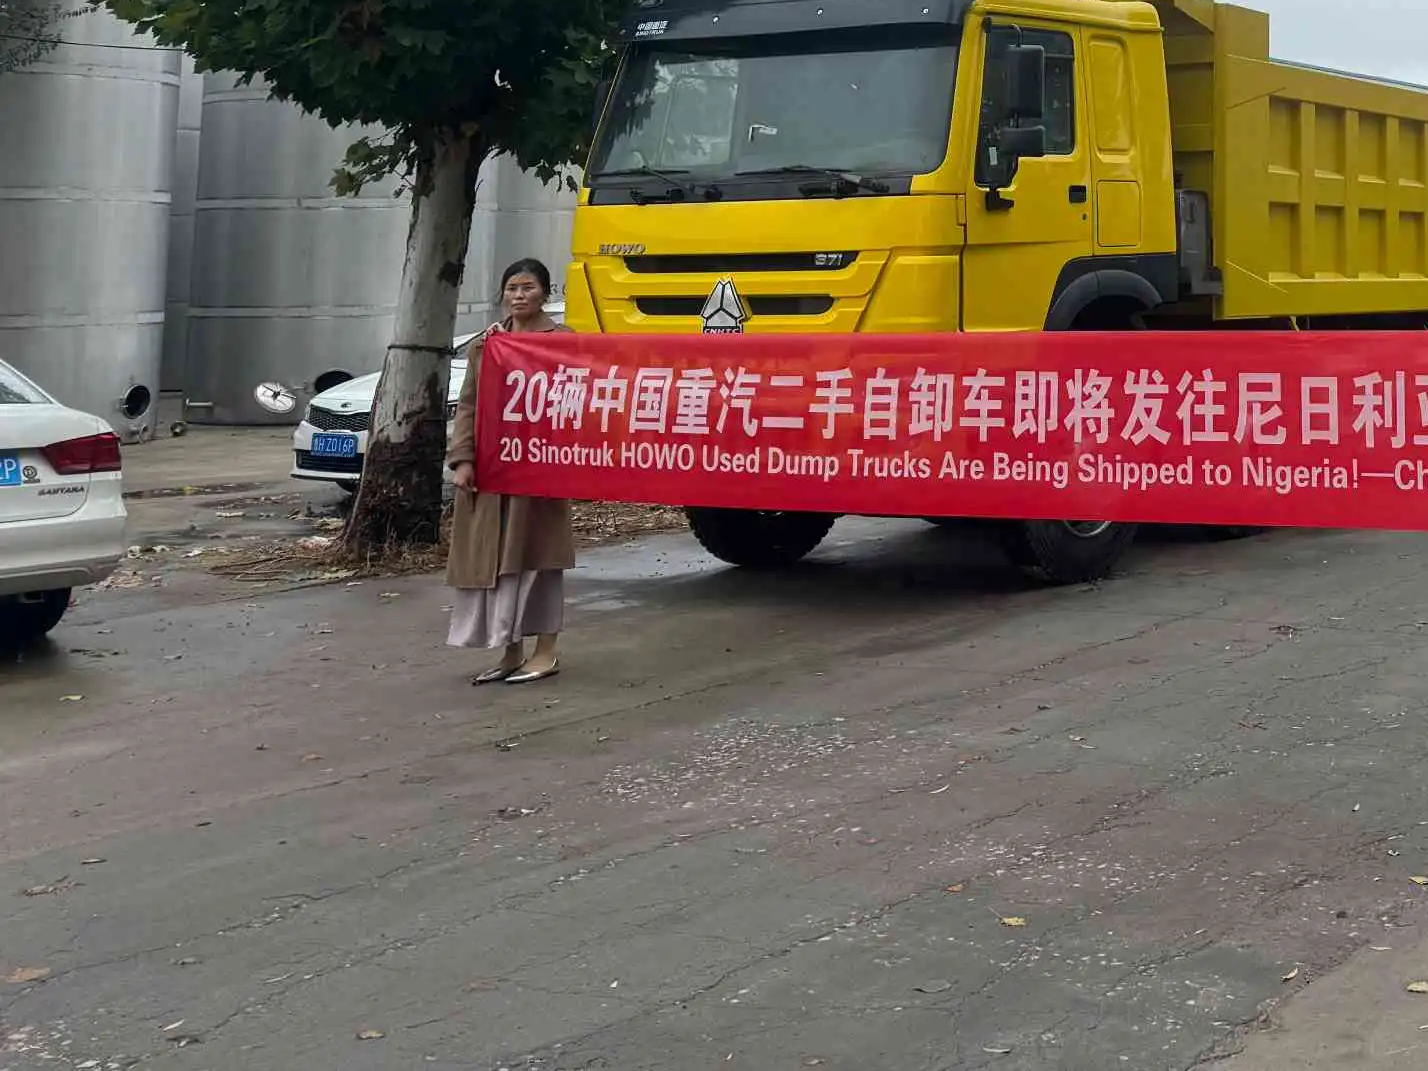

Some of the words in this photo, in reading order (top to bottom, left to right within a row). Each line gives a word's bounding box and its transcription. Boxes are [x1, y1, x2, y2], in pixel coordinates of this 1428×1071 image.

[500, 437, 522, 462] 20
[528, 438, 614, 467] Sinotruk
[620, 441, 695, 471] HOWO
[702, 444, 760, 474] Used
[767, 447, 840, 482] Dump
[848, 448, 931, 479] Trucks
[938, 451, 985, 480] Are
[993, 452, 1069, 489] Being
[1078, 453, 1193, 491] Shipped
[1202, 459, 1232, 486] to
